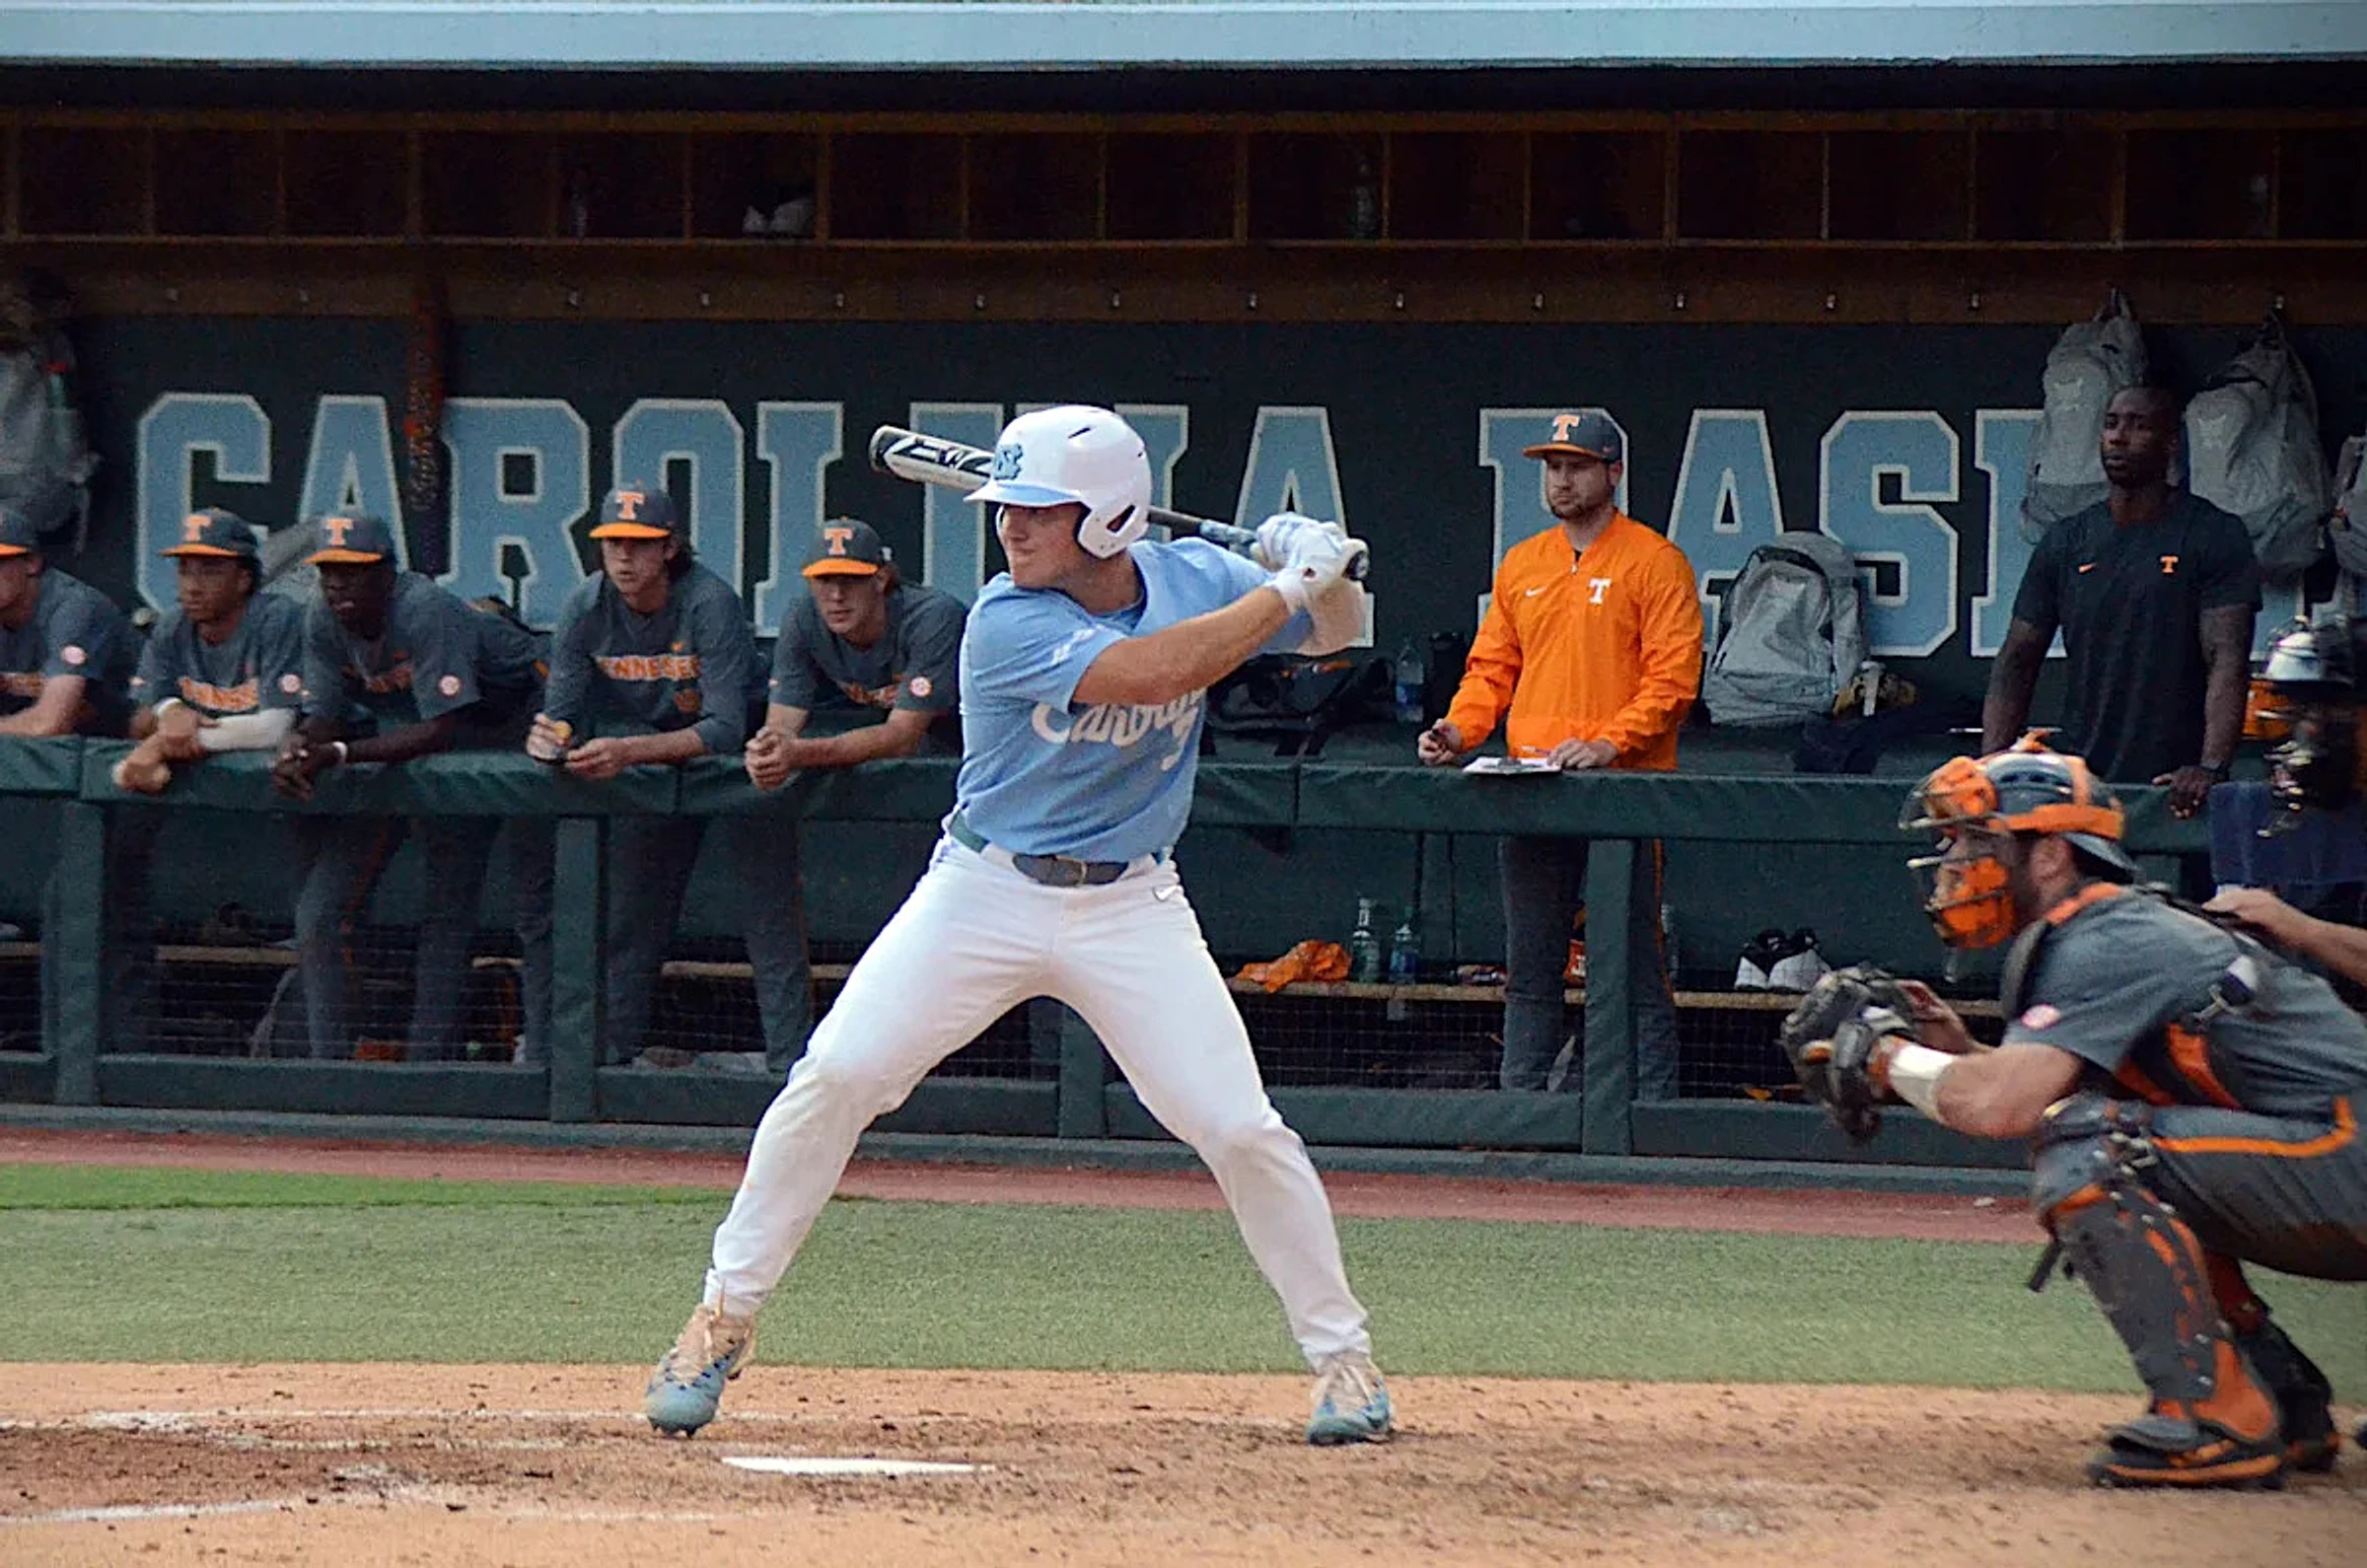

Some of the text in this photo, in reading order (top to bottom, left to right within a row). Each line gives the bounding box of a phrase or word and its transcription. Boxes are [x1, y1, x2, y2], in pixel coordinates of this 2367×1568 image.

[1552, 413, 1581, 442] T
[615, 490, 645, 520] T
[183, 515, 212, 541] T
[323, 517, 354, 545] T
[825, 527, 853, 556] T
[2160, 554, 2180, 574] T
[1588, 577, 1612, 605] T
